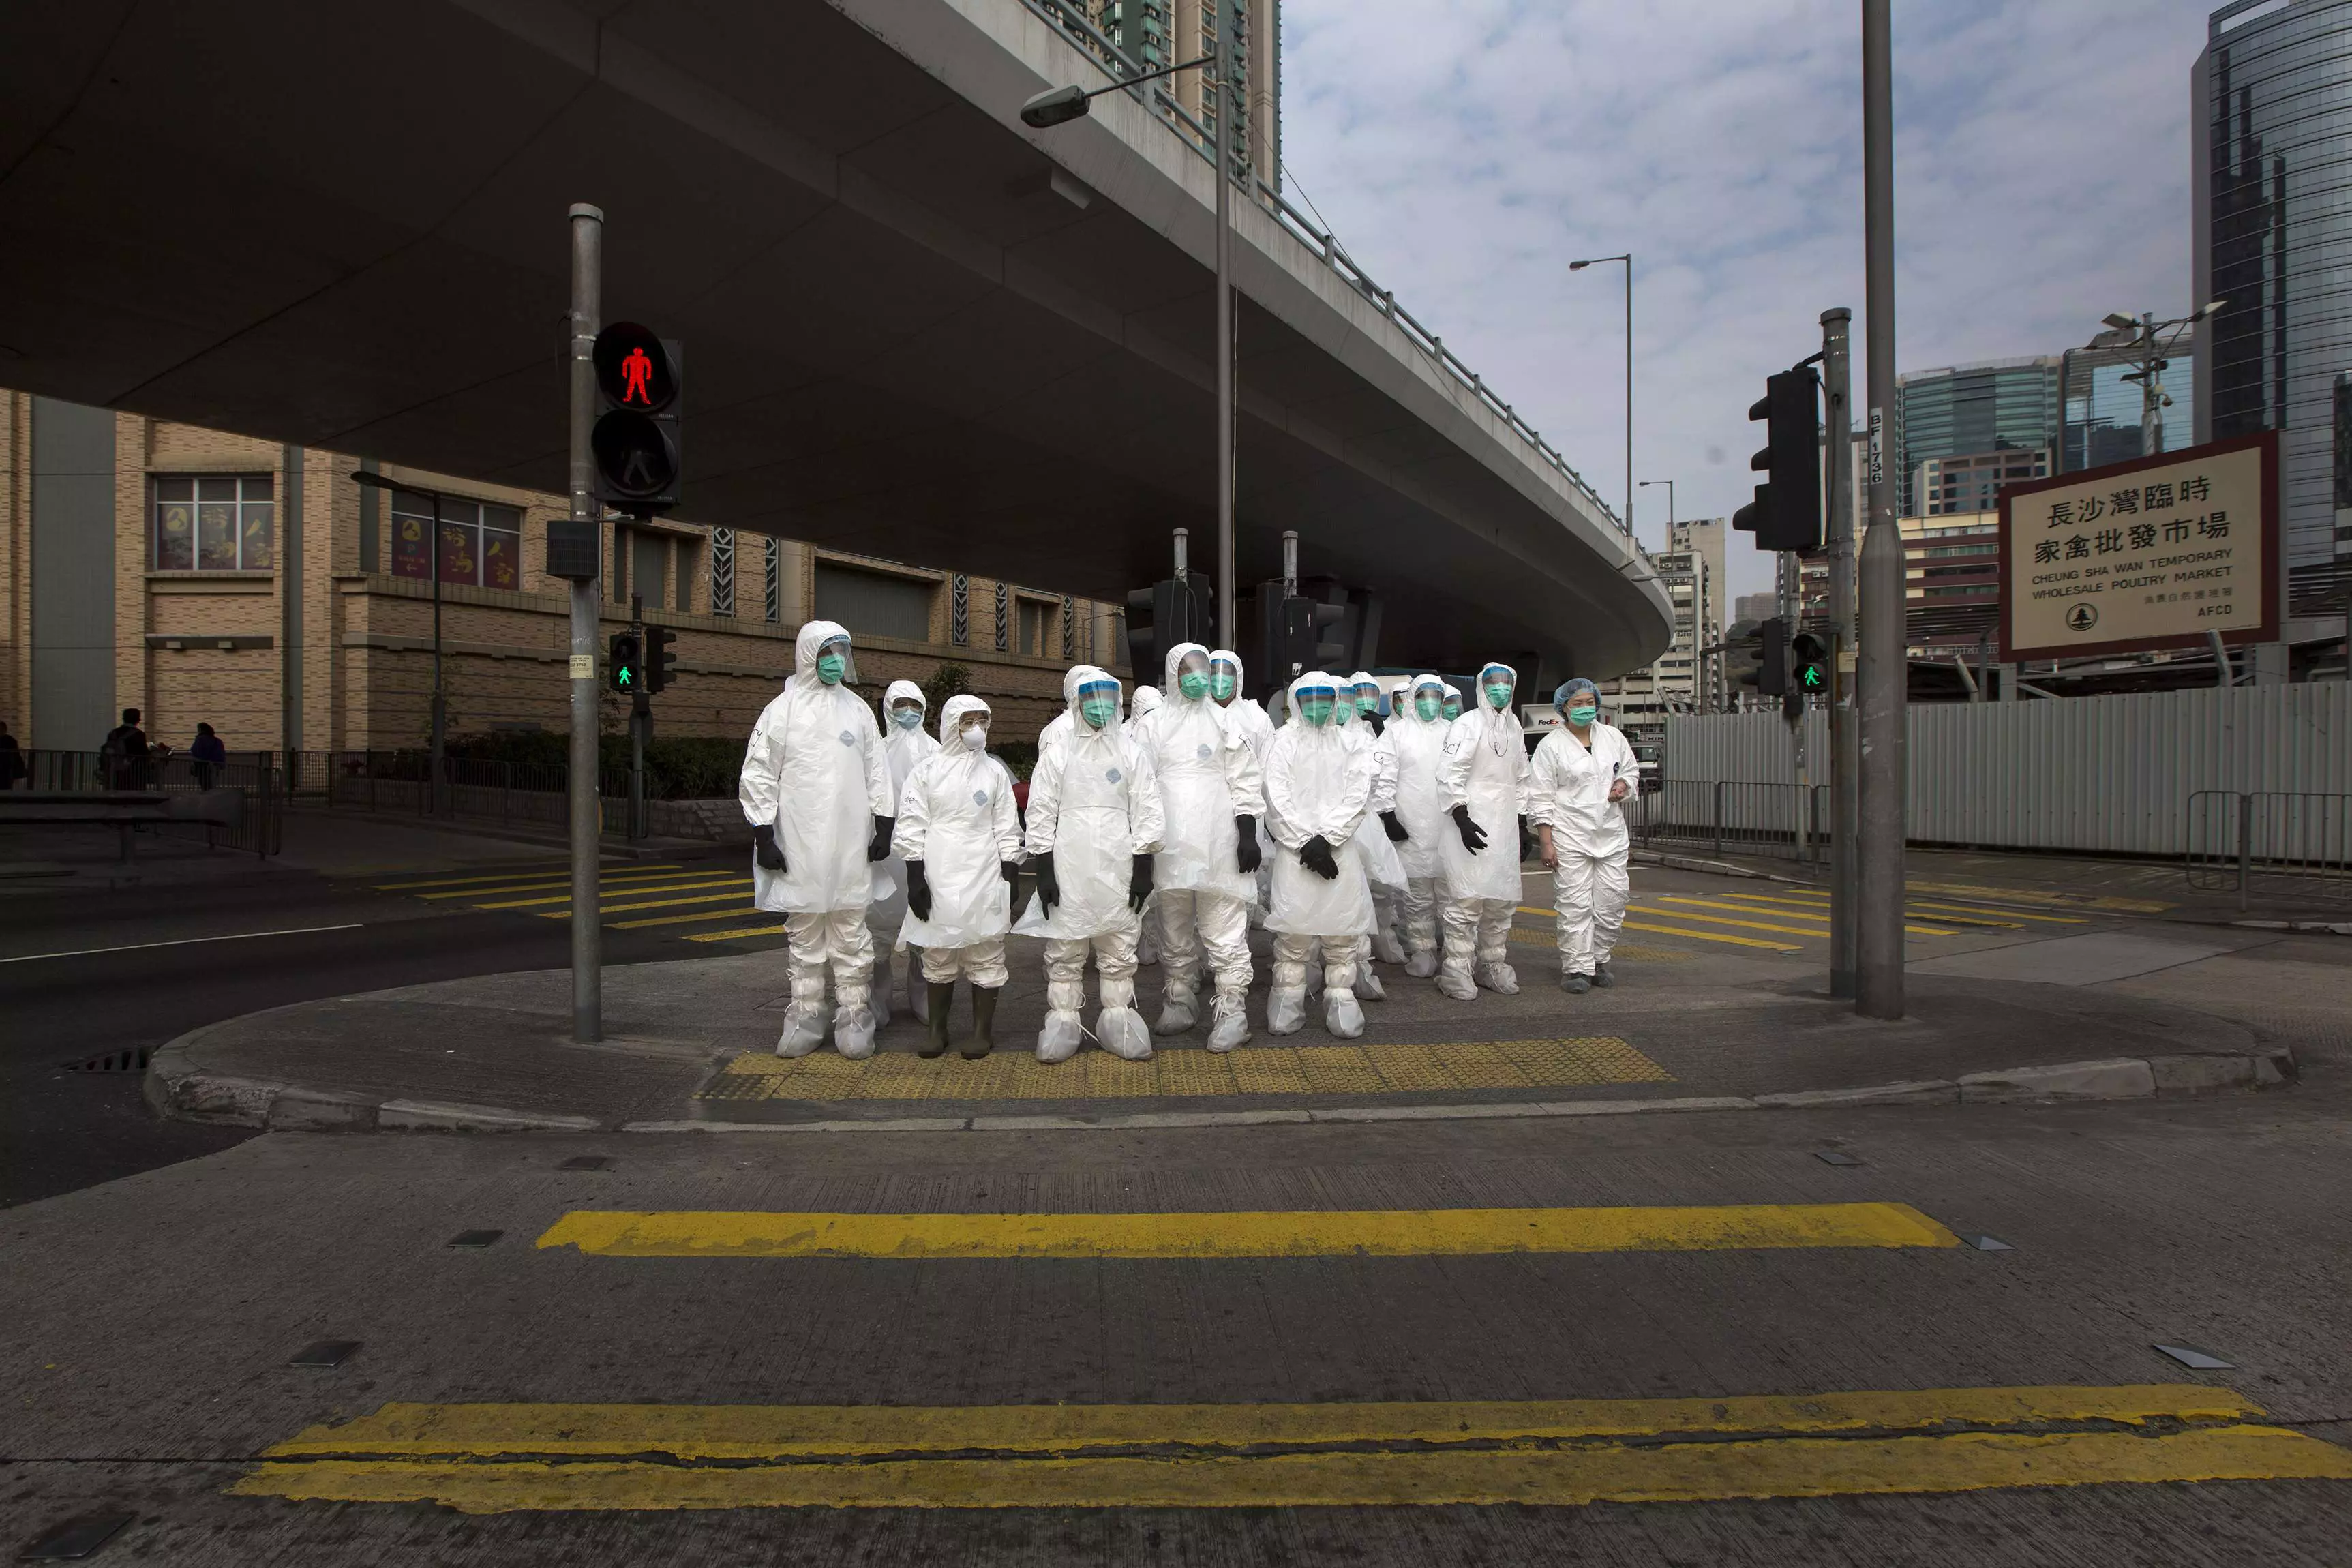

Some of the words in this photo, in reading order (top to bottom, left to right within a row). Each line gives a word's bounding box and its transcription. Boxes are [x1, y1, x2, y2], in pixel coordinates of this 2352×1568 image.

[1871, 414, 1881, 437] BF
[1871, 442, 1882, 483] 1736
[2047, 475, 2211, 528] 長沙灣臨時
[2034, 511, 2231, 564] 家禽批發市場
[2032, 570, 2079, 585] CHEUNG
[2085, 565, 2109, 578] SHA
[2114, 561, 2143, 574] WAN
[2150, 548, 2233, 568] TEMPORARY
[2032, 583, 2104, 600] WHOLESALE
[2112, 574, 2167, 590] POULTRY
[2175, 566, 2233, 582] MARKET
[2197, 605, 2233, 617] AFCD
